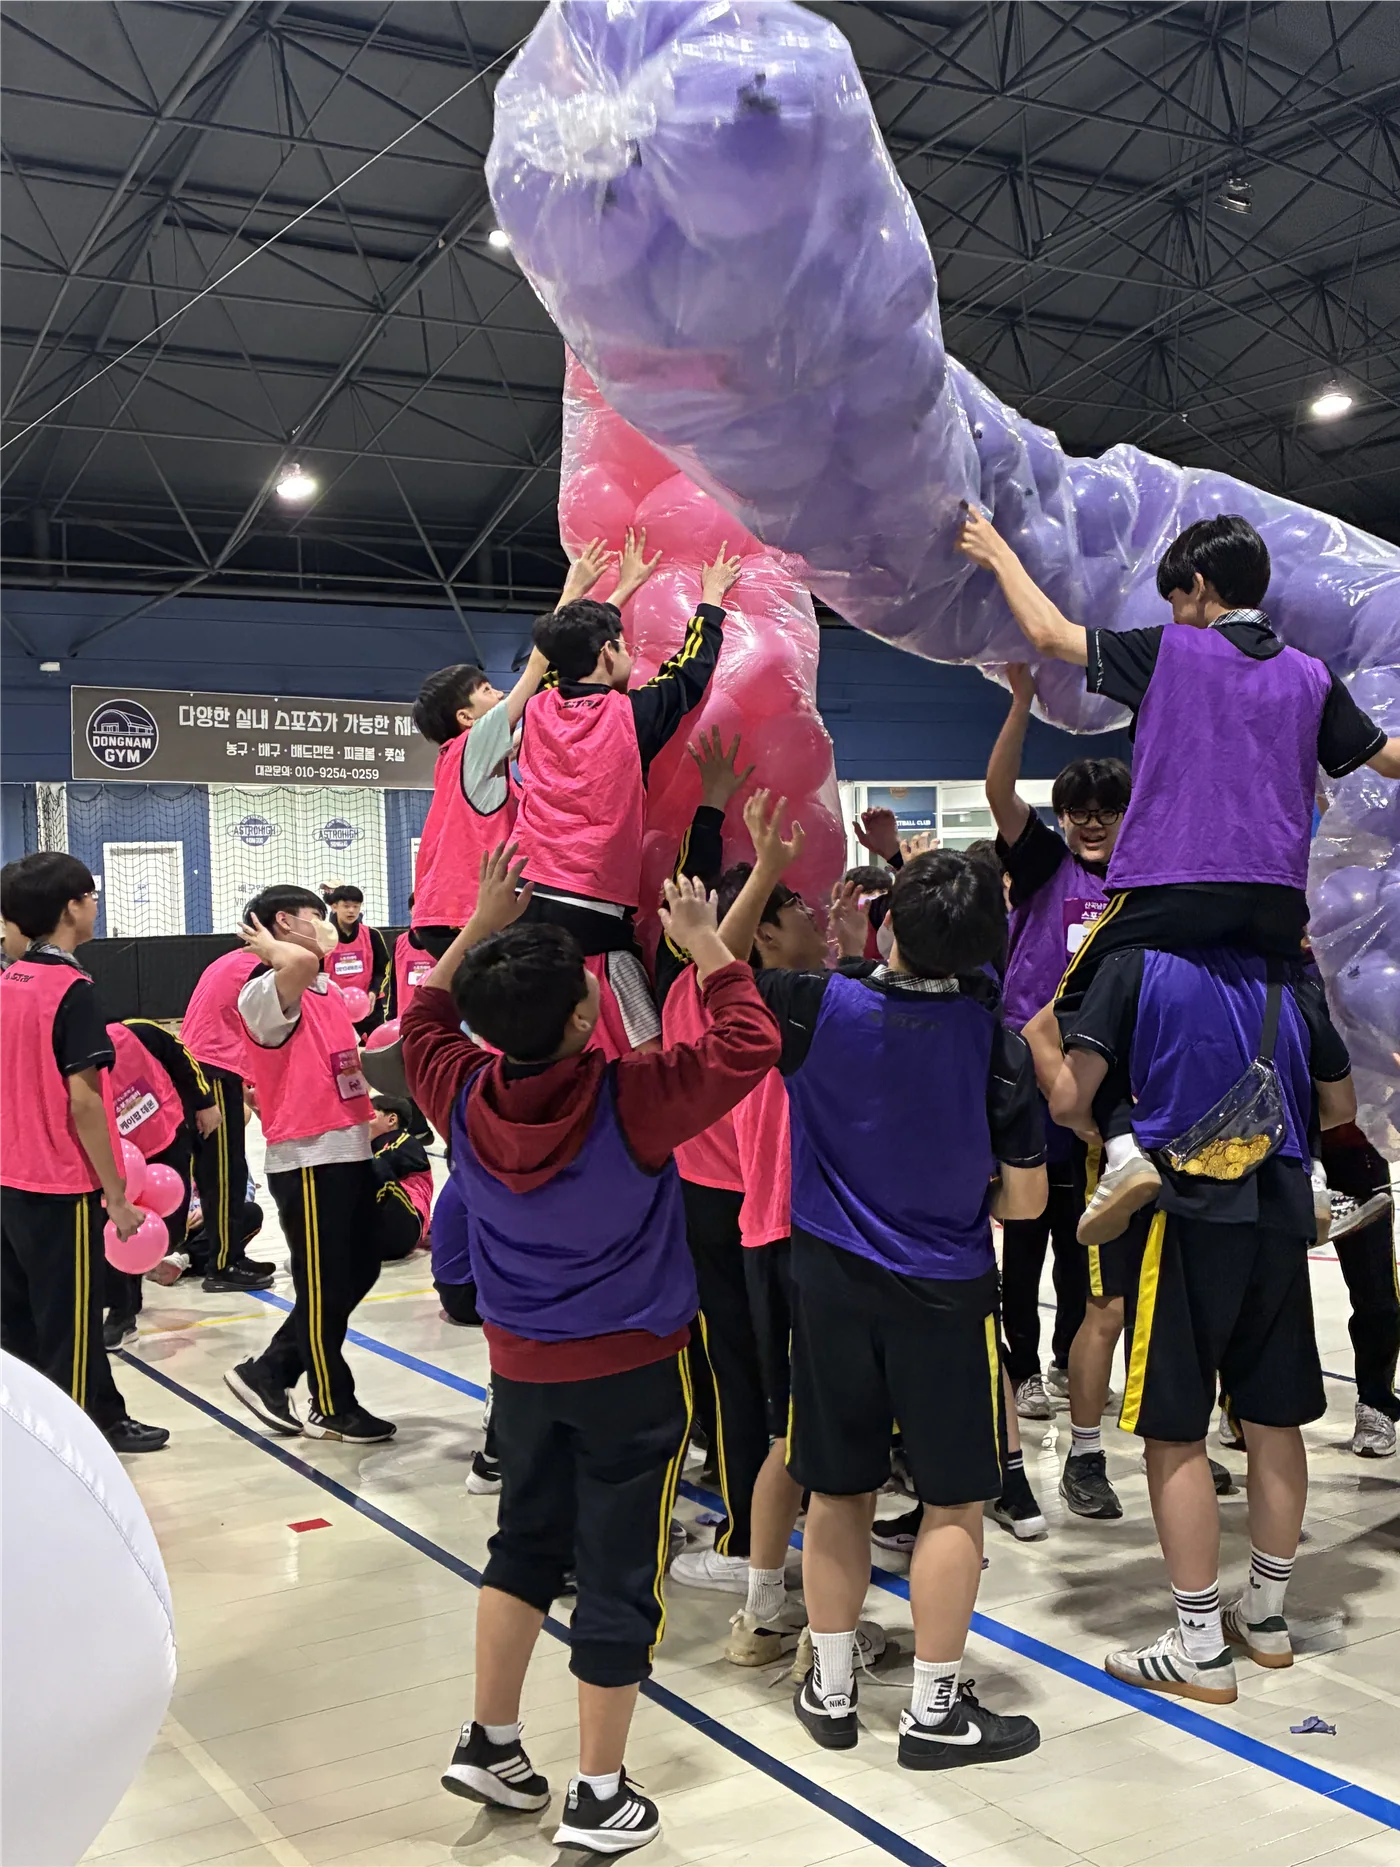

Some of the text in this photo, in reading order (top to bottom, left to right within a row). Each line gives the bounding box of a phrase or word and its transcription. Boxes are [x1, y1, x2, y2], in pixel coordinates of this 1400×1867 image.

[179, 705, 421, 736] 다양한 실내 스포츠가 가능한 체
[92, 735, 152, 750] DONGNAM
[104, 748, 141, 763] GYM
[226, 741, 405, 762] 농구 배구 배드민턴 피클볼 풋살
[255, 764, 380, 780] 대관문의: 010-9254-0259
[120, 1111, 142, 1130] 케이팝
[828, 1698, 847, 1708] NIKE
